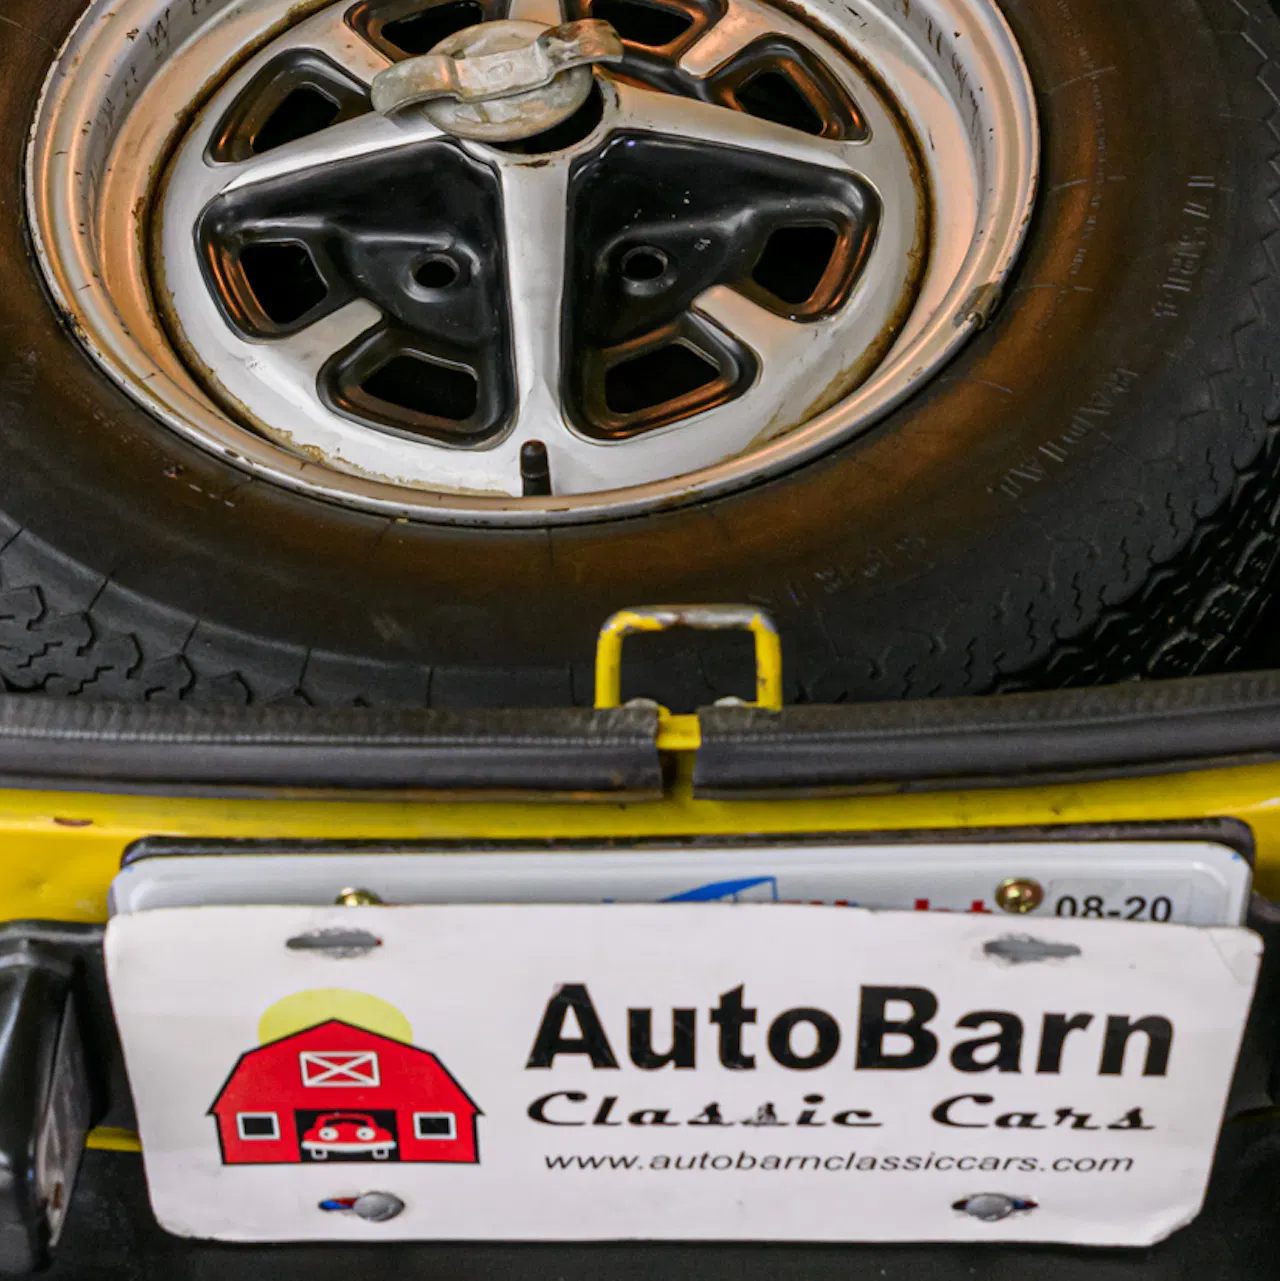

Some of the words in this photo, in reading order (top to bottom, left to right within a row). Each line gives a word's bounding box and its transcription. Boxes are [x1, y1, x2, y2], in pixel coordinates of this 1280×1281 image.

[1055, 895, 1173, 922] 08-20
[525, 983, 1174, 1077] AutoBarn
[526, 1090, 883, 1128] Classic
[931, 1093, 1155, 1132] Cars
[544, 1150, 1134, 1174] www.autobarnclassiccars.com
